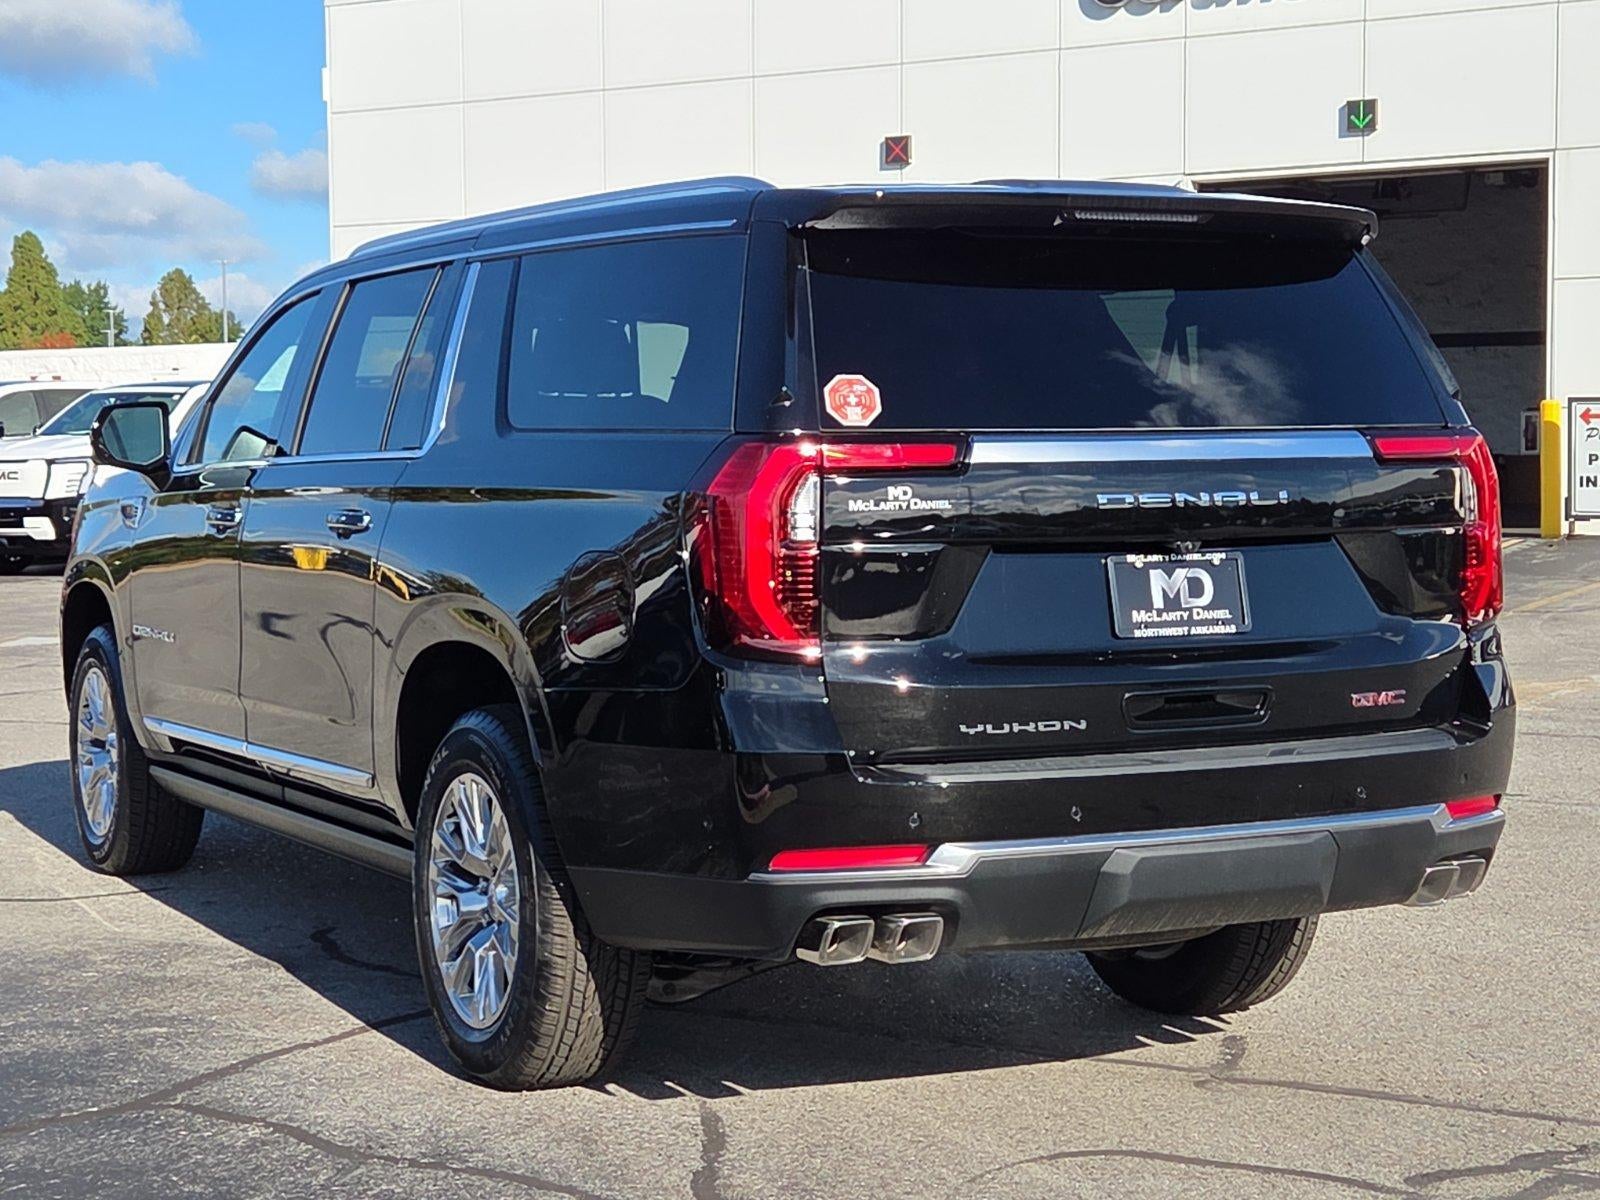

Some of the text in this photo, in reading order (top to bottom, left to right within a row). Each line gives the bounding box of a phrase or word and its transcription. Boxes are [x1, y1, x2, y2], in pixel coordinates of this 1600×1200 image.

[1579, 475, 1600, 488] IN
[887, 485, 913, 501] MD
[1097, 490, 1289, 509] DENALI
[910, 498, 952, 510] DANIEL
[1149, 567, 1214, 609] MD
[1192, 608, 1232, 620] DANIEL
[1134, 624, 1237, 638] NORTHWEST ARKANSAS
[1350, 689, 1406, 707] GMC
[959, 719, 1087, 735] YUKON
